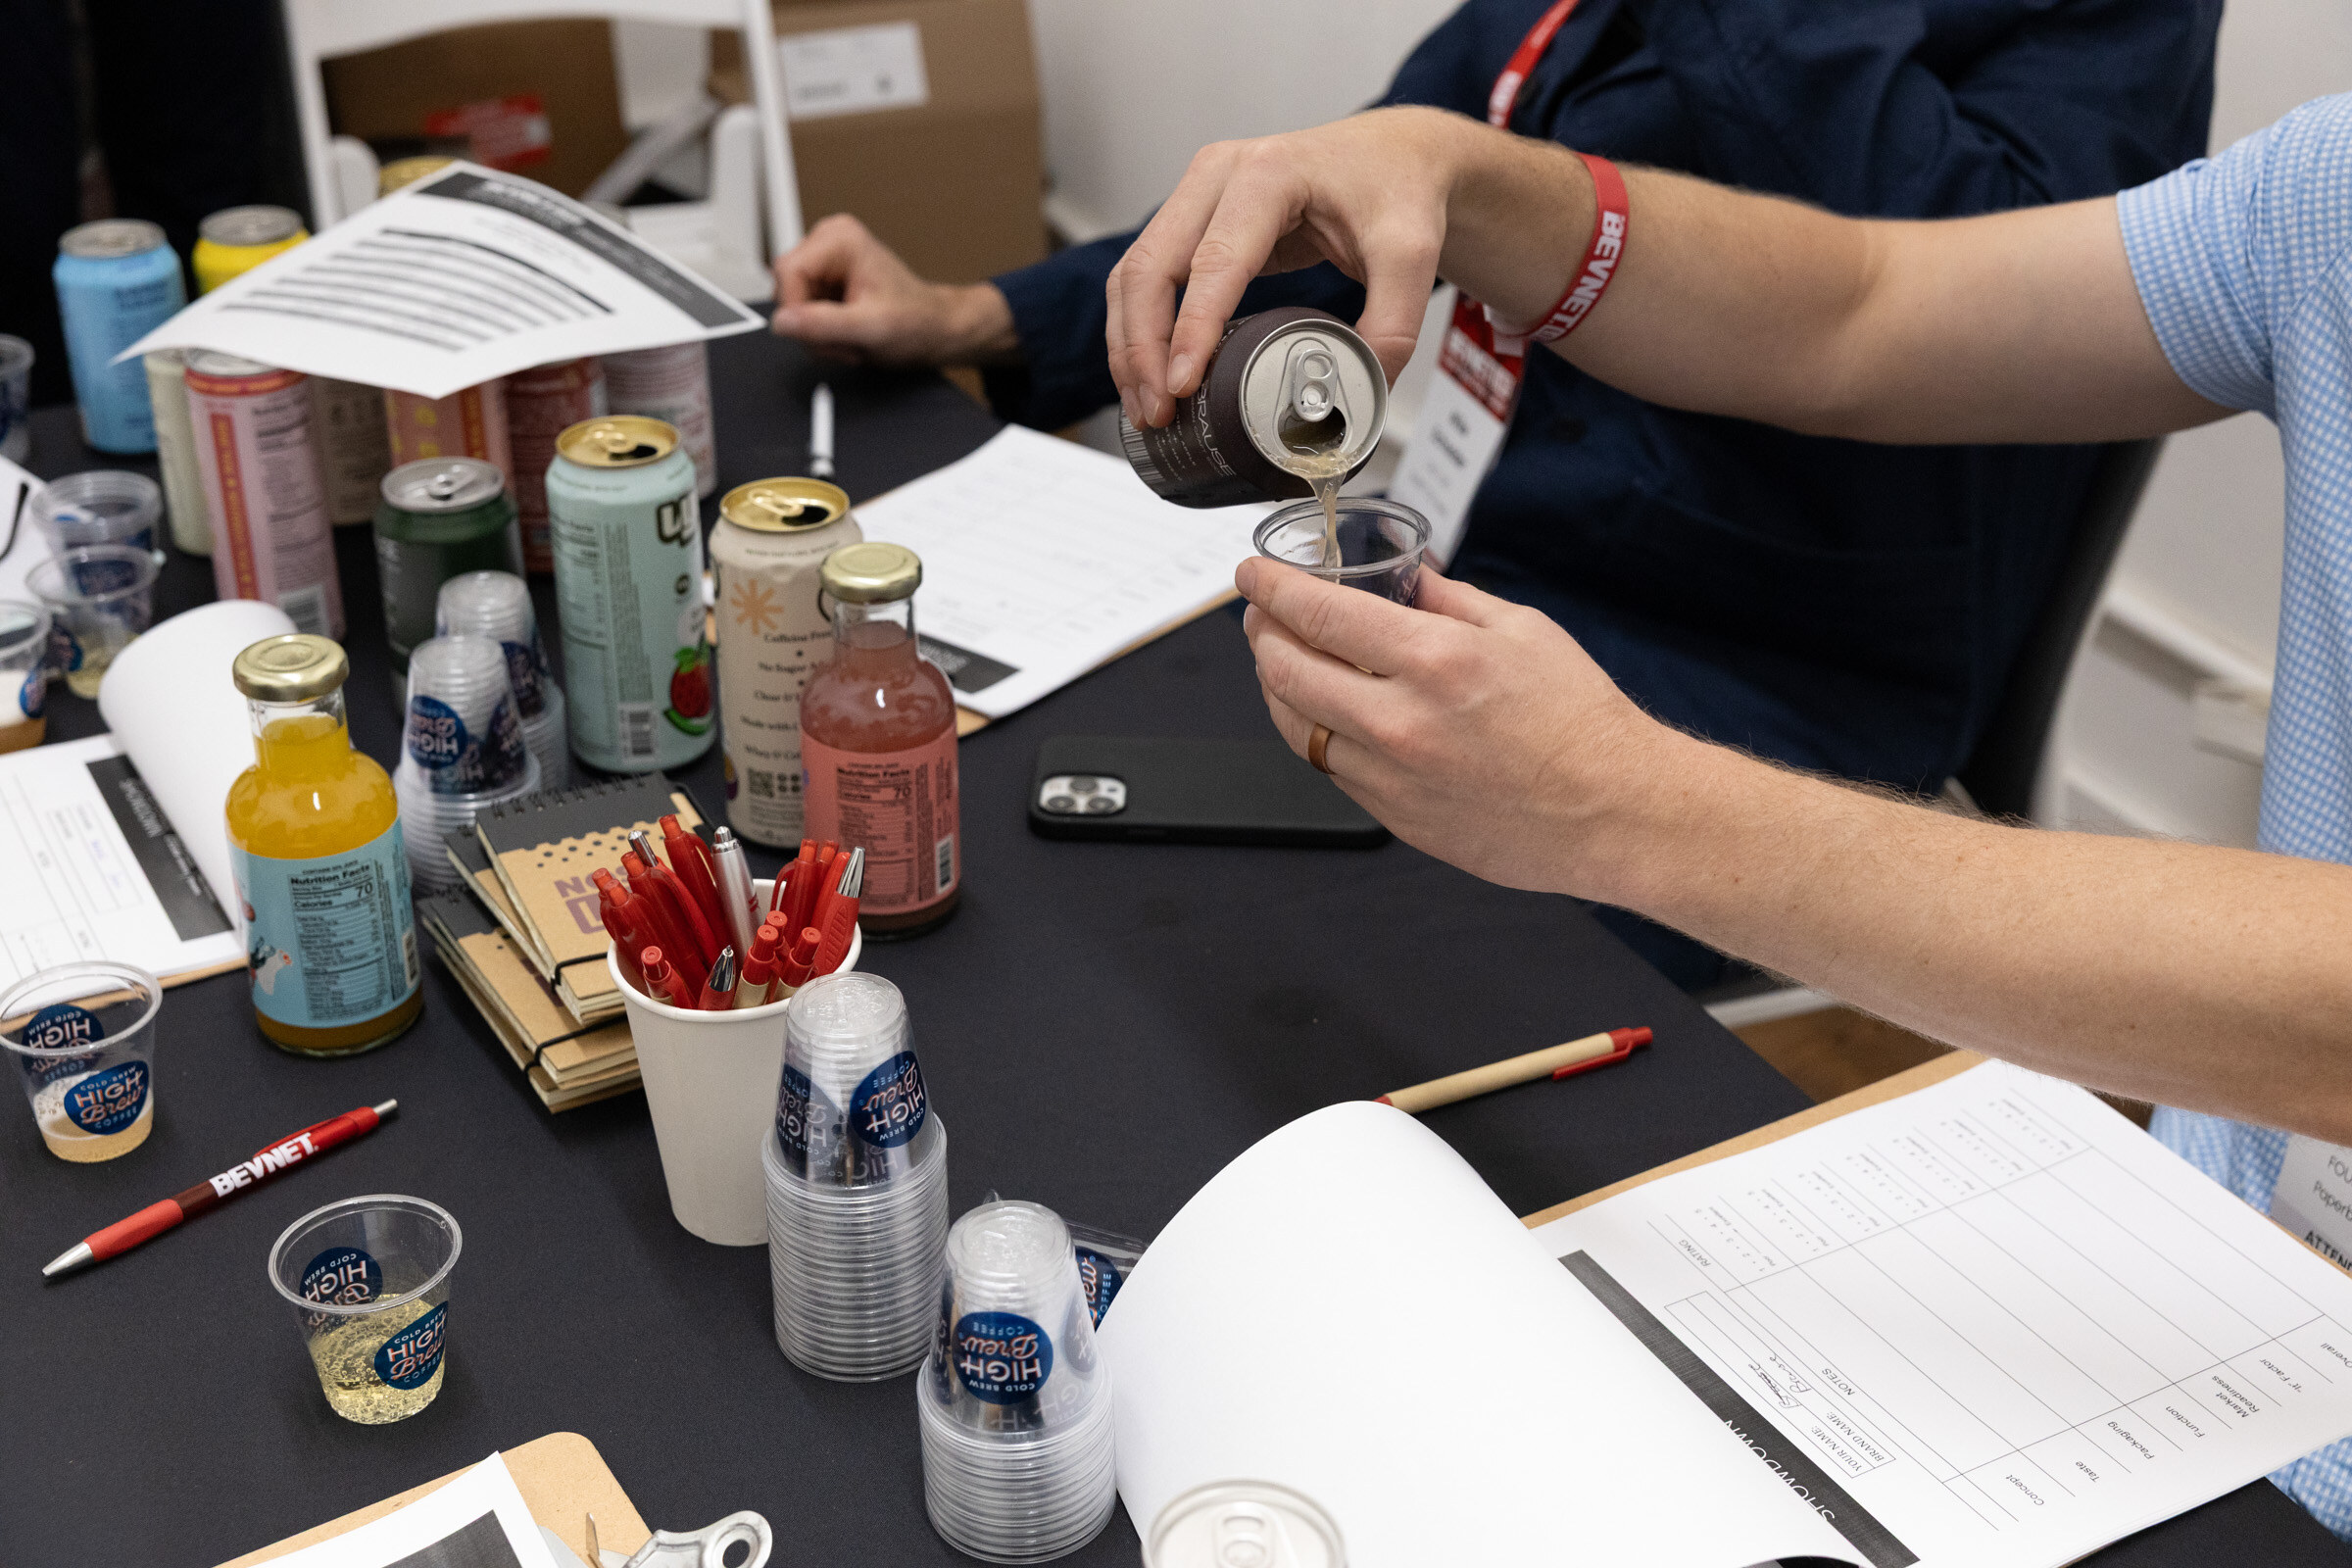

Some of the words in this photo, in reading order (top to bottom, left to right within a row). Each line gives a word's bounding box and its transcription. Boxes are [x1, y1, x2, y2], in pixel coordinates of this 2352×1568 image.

[895, 786, 912, 800] 70
[290, 873, 340, 886] Nutrition
[343, 863, 370, 879] Facts
[294, 900, 333, 908] Calories
[356, 881, 373, 899] 70
[80, 1079, 107, 1091] COLD
[113, 1065, 136, 1083] BREW
[862, 1062, 917, 1111] Brew
[873, 1060, 910, 1088] COFFEE
[74, 1070, 143, 1107] HIGH
[80, 1085, 145, 1124] Brew
[866, 1084, 924, 1133] HIGH
[908, 1107, 924, 1127] COLD
[879, 1126, 906, 1141] BREW
[209, 1132, 315, 1198] BEVNET
[1679, 1239, 1711, 1267] RATING
[387, 1312, 447, 1362] HIGH
[394, 1329, 421, 1344] COLD
[424, 1307, 445, 1328] BREW
[973, 1322, 1024, 1336] COFFEE
[390, 1333, 446, 1380] Brew
[961, 1333, 1039, 1358] Brew
[959, 1354, 1043, 1382] HIGH
[2260, 1357, 2290, 1383] Factor
[969, 1379, 1000, 1392] BREW
[1005, 1383, 1035, 1393] COLD
[1822, 1368, 1856, 1396] NOTES
[2211, 1375, 2260, 1413] Readiness
[2216, 1392, 2249, 1419] Market
[1827, 1412, 1852, 1437] NAME:
[2166, 1405, 2206, 1438] Function
[1811, 1425, 1836, 1450] NAME:
[1852, 1436, 1885, 1462] BRAND
[2107, 1420, 2155, 1460] Packaging
[1837, 1449, 1862, 1471] YOUR
[2076, 1460, 2099, 1483] Taste
[2005, 1473, 2044, 1507] Concept
